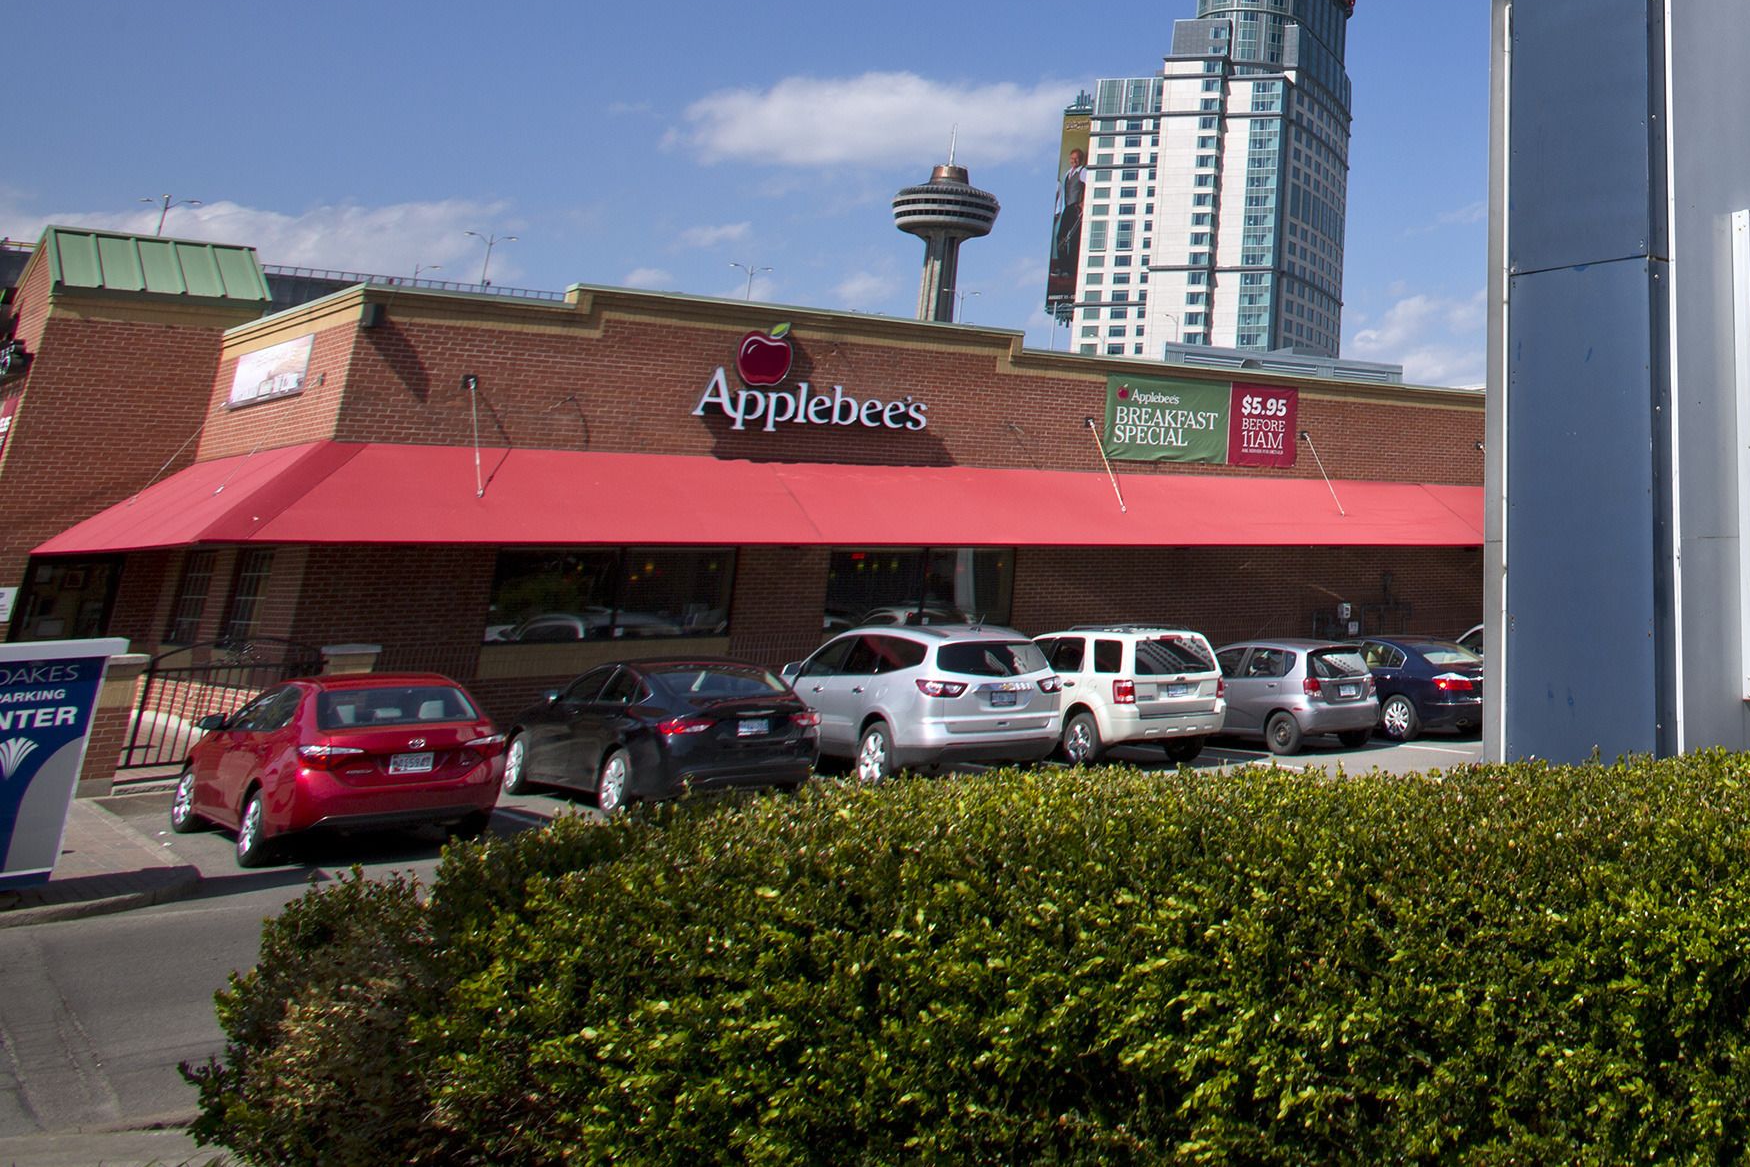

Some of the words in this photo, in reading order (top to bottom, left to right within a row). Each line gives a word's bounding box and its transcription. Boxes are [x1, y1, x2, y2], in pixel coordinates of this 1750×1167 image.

[691, 365, 929, 432] Applebee's
[1241, 394, 1288, 416] $5.95
[1115, 405, 1219, 430] BREAKFAST
[1241, 417, 1286, 432] BEFORE
[1113, 424, 1188, 447] SPECIAL
[1241, 430, 1284, 449] 11AM
[0, 688, 66, 704] ARKING
